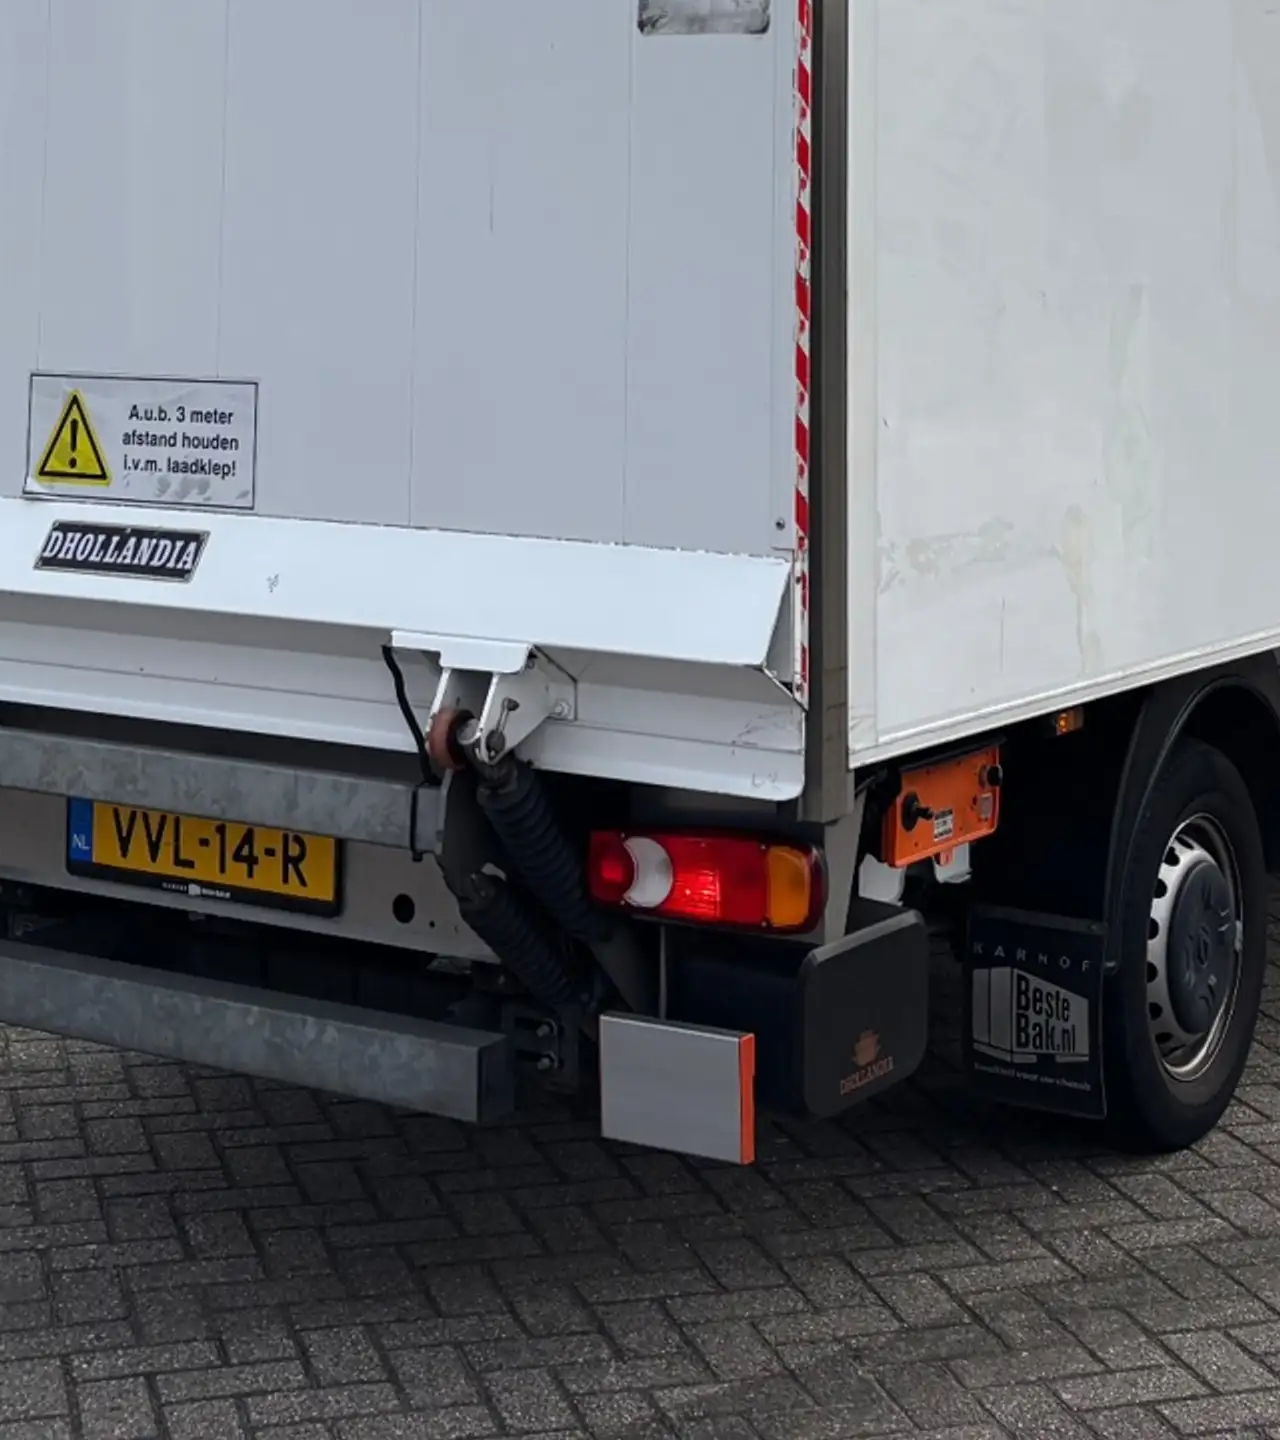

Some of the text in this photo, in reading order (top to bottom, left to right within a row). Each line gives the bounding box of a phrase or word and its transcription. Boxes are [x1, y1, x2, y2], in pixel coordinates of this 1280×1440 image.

[127, 404, 234, 425] A.u.b. 3 meter
[122, 429, 239, 451] afstand houden
[123, 454, 236, 480] i.v.m. laadklep!
[42, 529, 199, 571] DHOLLANDIA
[71, 833, 91, 851] NL
[111, 806, 308, 888] VVL-14-R
[1016, 972, 1071, 1023] Beste
[1016, 1012, 1076, 1054] Bak.nl
